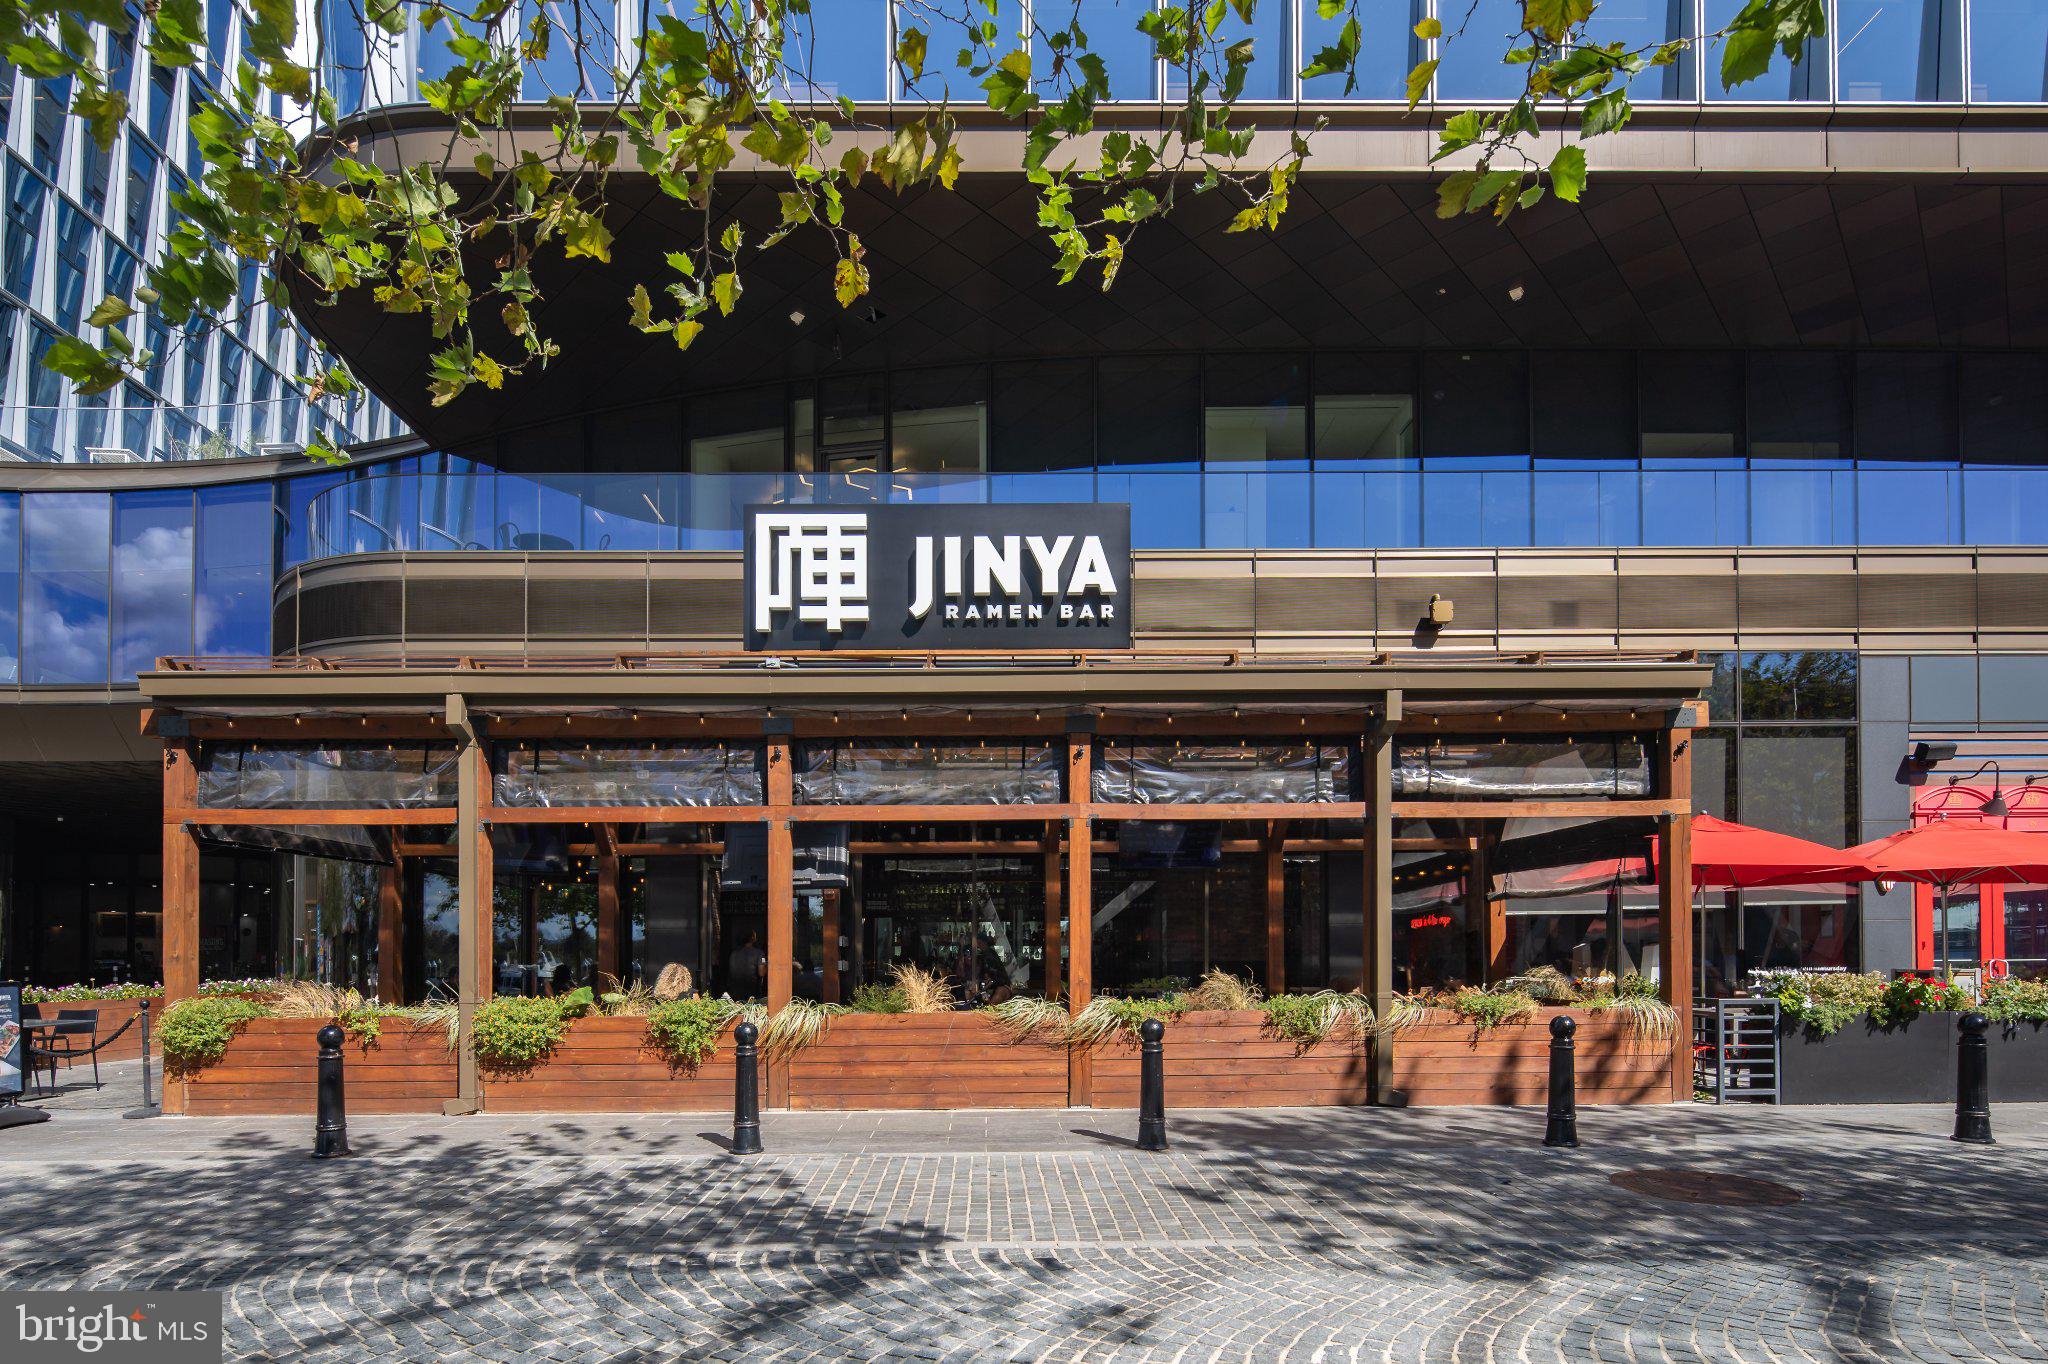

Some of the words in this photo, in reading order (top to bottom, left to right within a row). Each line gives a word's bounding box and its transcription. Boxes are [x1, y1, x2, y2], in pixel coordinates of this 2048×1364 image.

[908, 535, 1118, 620] JINYA
[945, 604, 1043, 620] RAMEN
[1060, 604, 1115, 619] BAR
